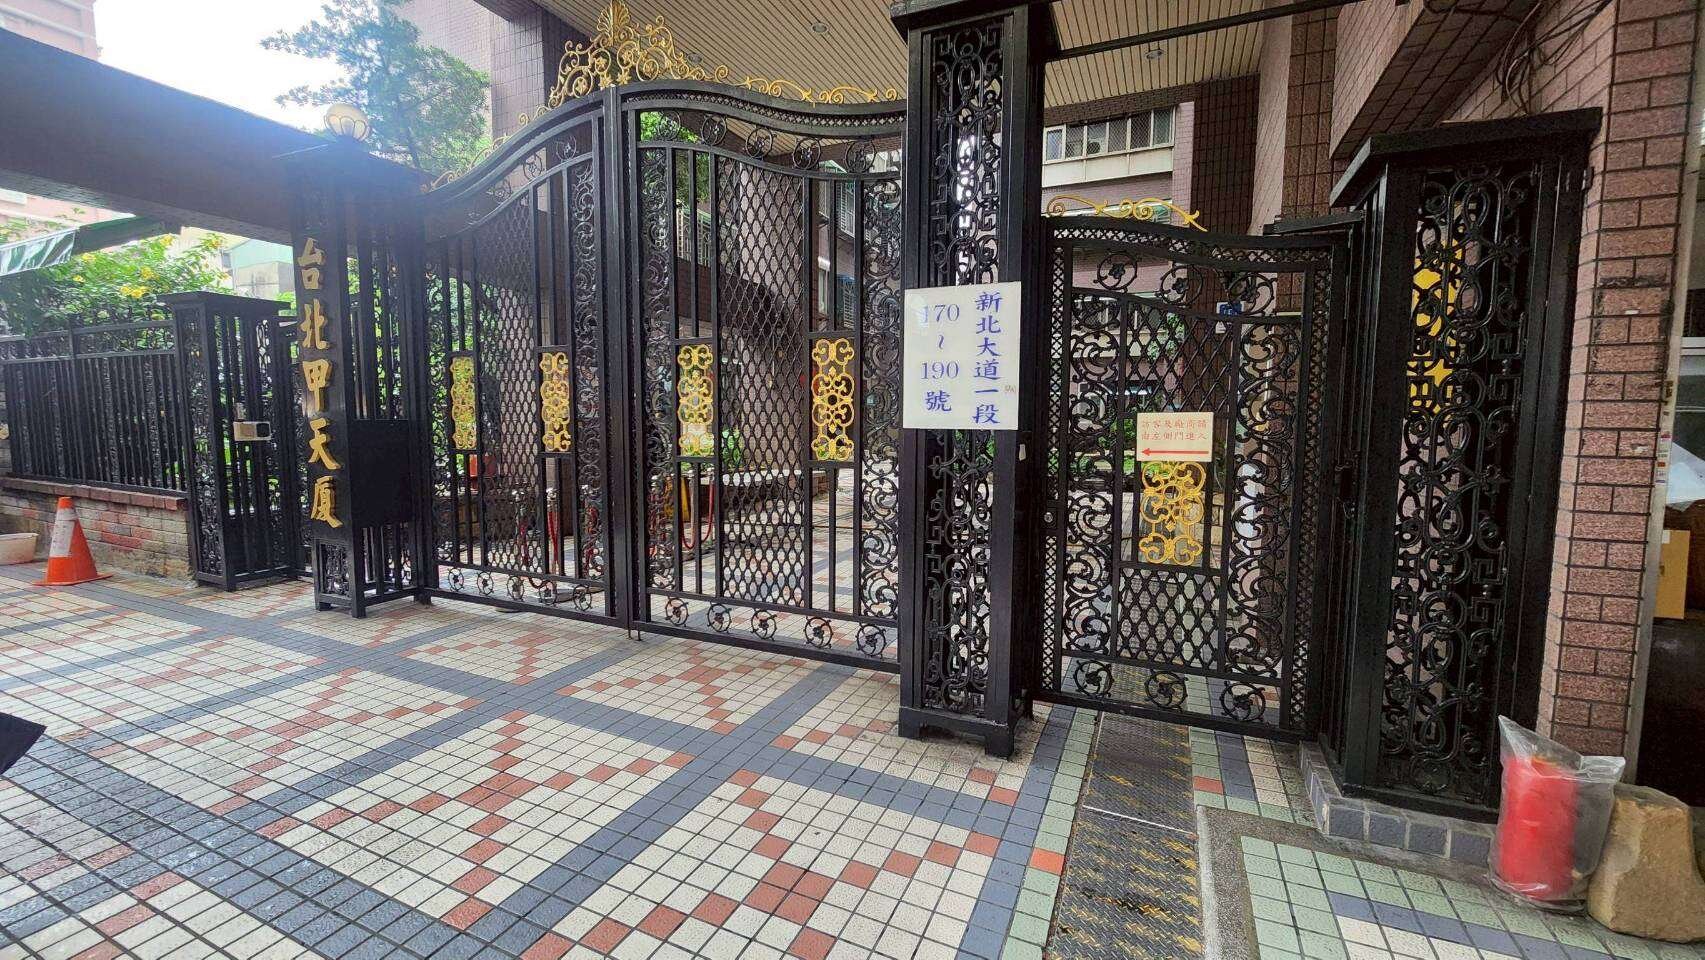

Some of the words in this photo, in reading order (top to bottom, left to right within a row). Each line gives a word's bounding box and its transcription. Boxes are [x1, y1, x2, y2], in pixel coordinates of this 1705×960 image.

[297, 237, 343, 529] 台北甲天廈
[972, 290, 1004, 426] 新北大道一段
